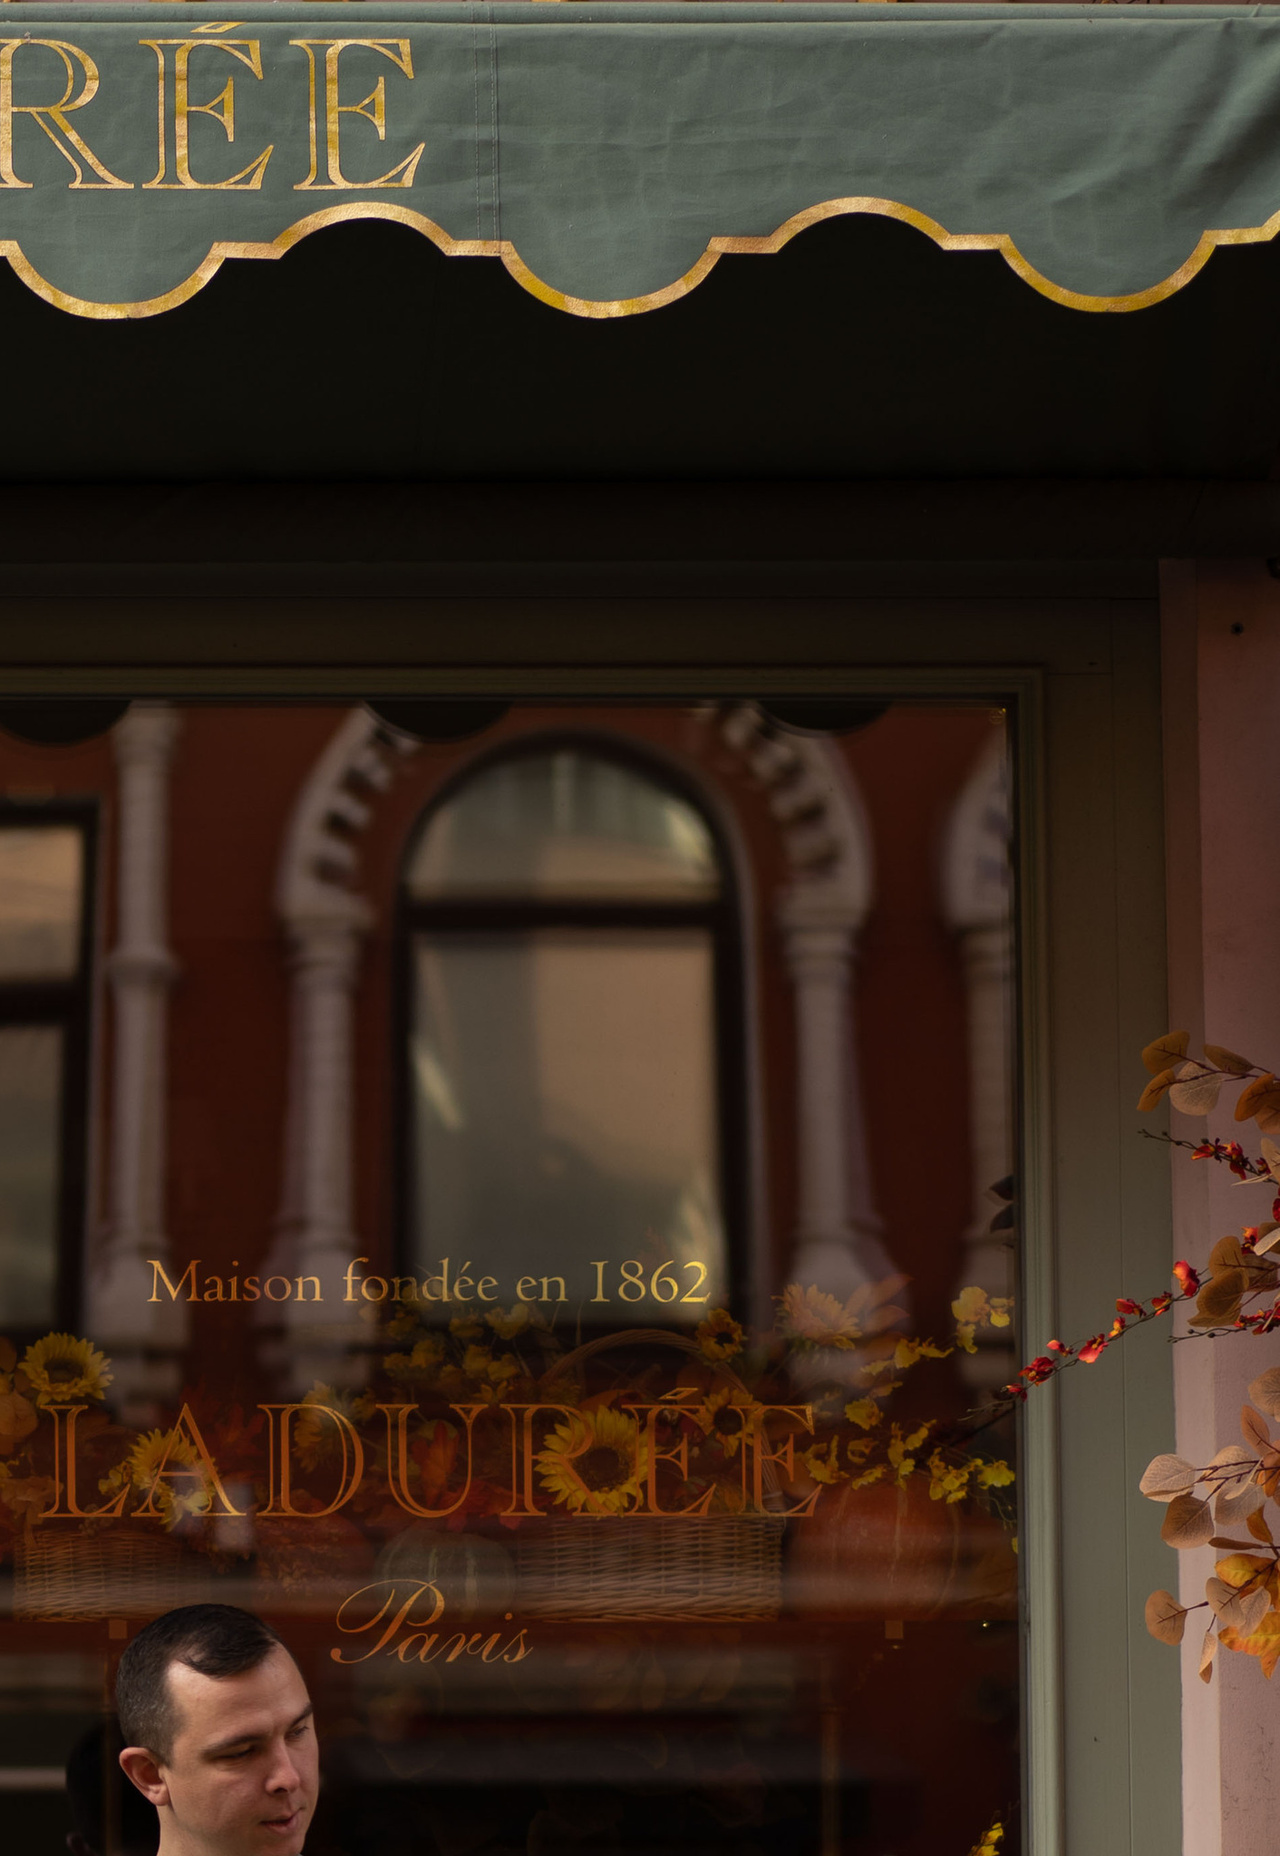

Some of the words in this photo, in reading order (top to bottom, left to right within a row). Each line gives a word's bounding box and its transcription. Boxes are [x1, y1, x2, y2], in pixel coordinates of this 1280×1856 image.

[147, 1260, 324, 1304] Maison
[342, 1257, 500, 1304] fondée
[517, 1276, 570, 1304] en
[590, 1260, 712, 1304] 1862
[38, 1387, 825, 1519] LADURÉE
[330, 1578, 535, 1666] Paris
